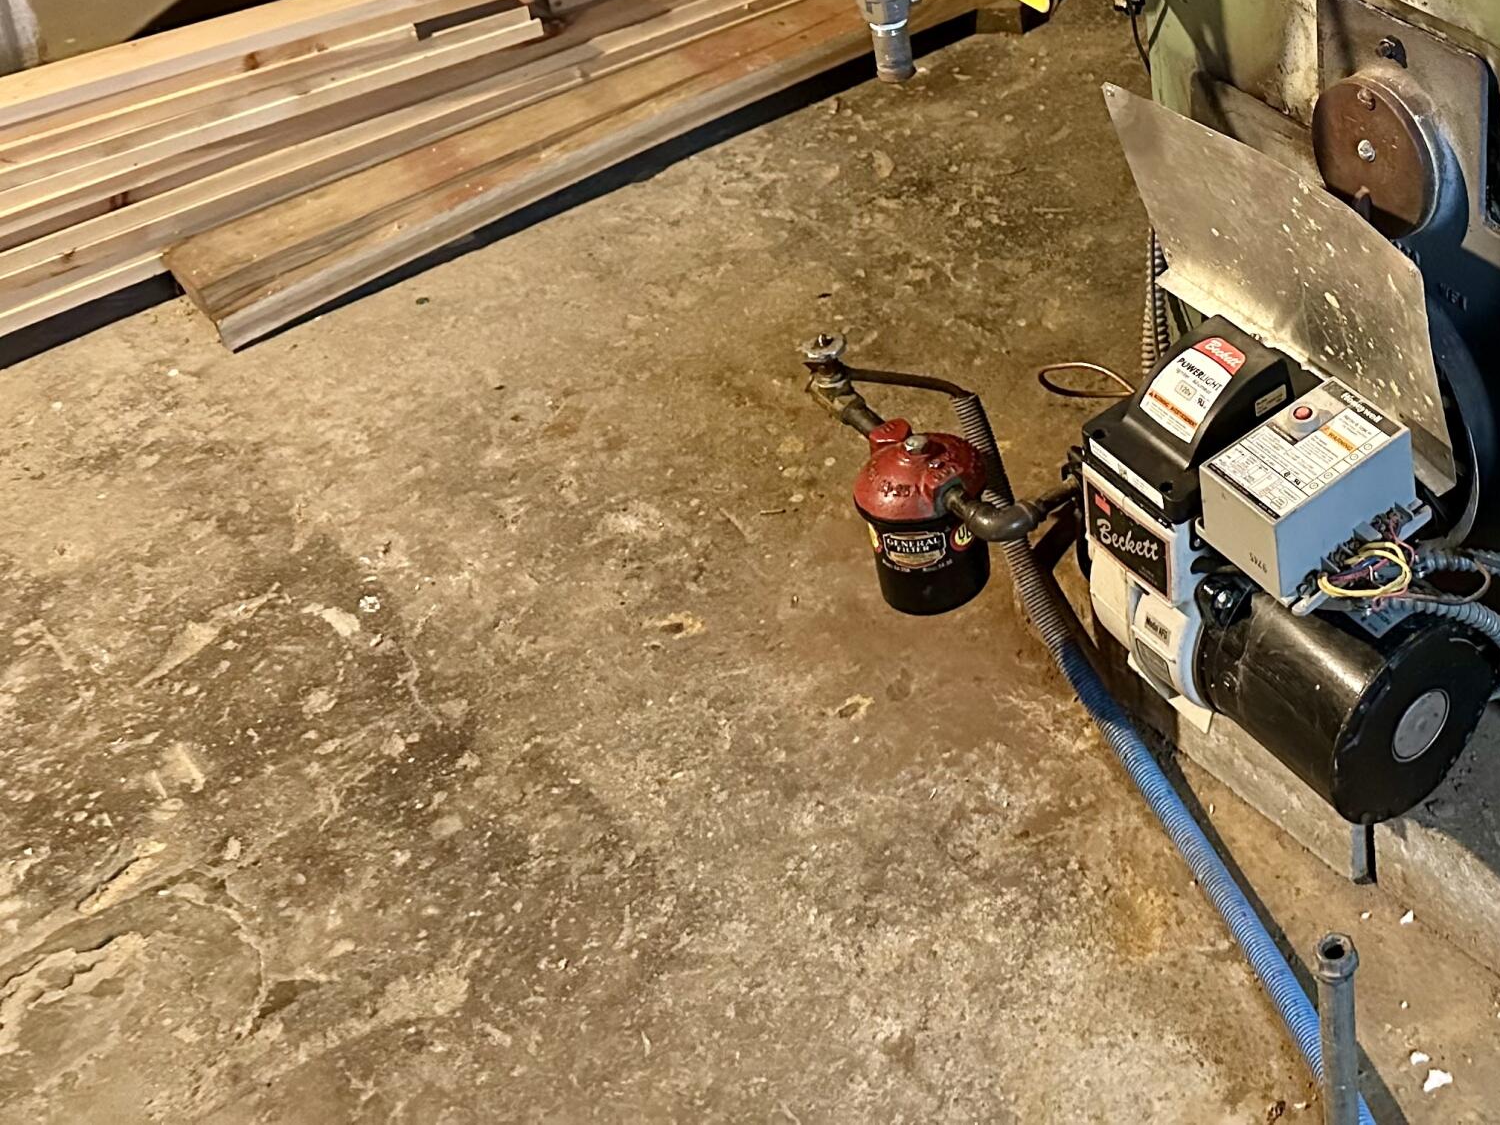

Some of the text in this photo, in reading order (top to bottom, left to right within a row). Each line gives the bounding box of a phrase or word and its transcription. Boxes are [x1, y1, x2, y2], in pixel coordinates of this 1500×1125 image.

[1204, 339, 1242, 369] Beckett
[1177, 357, 1223, 392] POWERLIGHT
[1341, 391, 1383, 423] Honeywell
[886, 536, 939, 547] GENERAL
[896, 545, 930, 553] FILTER
[1097, 518, 1159, 561] Beckett
